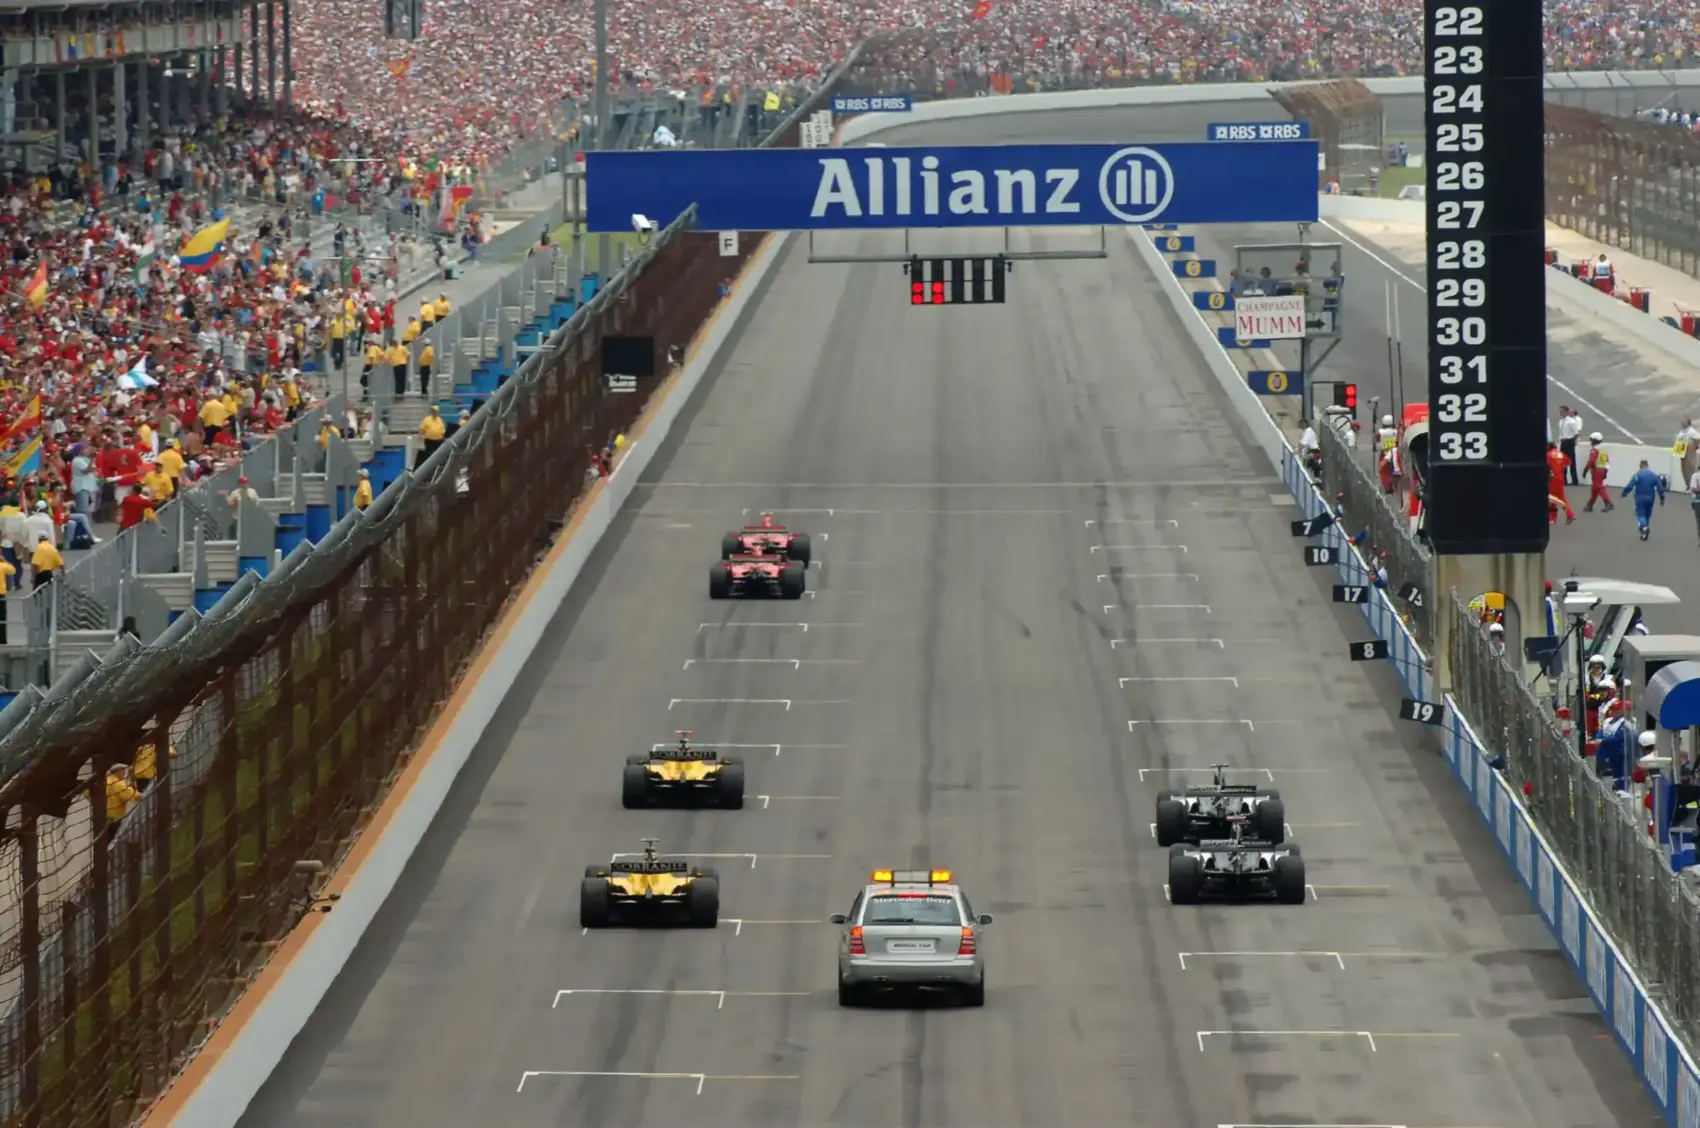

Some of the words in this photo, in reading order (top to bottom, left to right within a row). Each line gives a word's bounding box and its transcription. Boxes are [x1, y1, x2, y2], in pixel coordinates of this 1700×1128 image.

[1435, 7, 1483, 35] 22
[1434, 46, 1484, 74] 23
[1433, 84, 1484, 113] 24
[1229, 125, 1257, 139] RBS
[1274, 124, 1301, 138] RBS
[1436, 124, 1484, 151] 25
[811, 156, 1080, 217] Allianz
[1437, 162, 1484, 190] 26
[1437, 201, 1485, 228] 27
[1437, 241, 1485, 269] 28
[1437, 279, 1485, 306] 29
[1238, 301, 1302, 312] CHAMPAGNE
[1239, 315, 1302, 335] MUMM
[1437, 317, 1486, 345] 30
[1440, 355, 1487, 383] 31
[1438, 394, 1487, 422] 32
[1440, 432, 1487, 459] 33
[1303, 521, 1312, 535] 7
[1313, 548, 1329, 563] 10
[1344, 587, 1361, 602] 17
[1363, 642, 1375, 658] 8
[1412, 702, 1434, 722] 19
